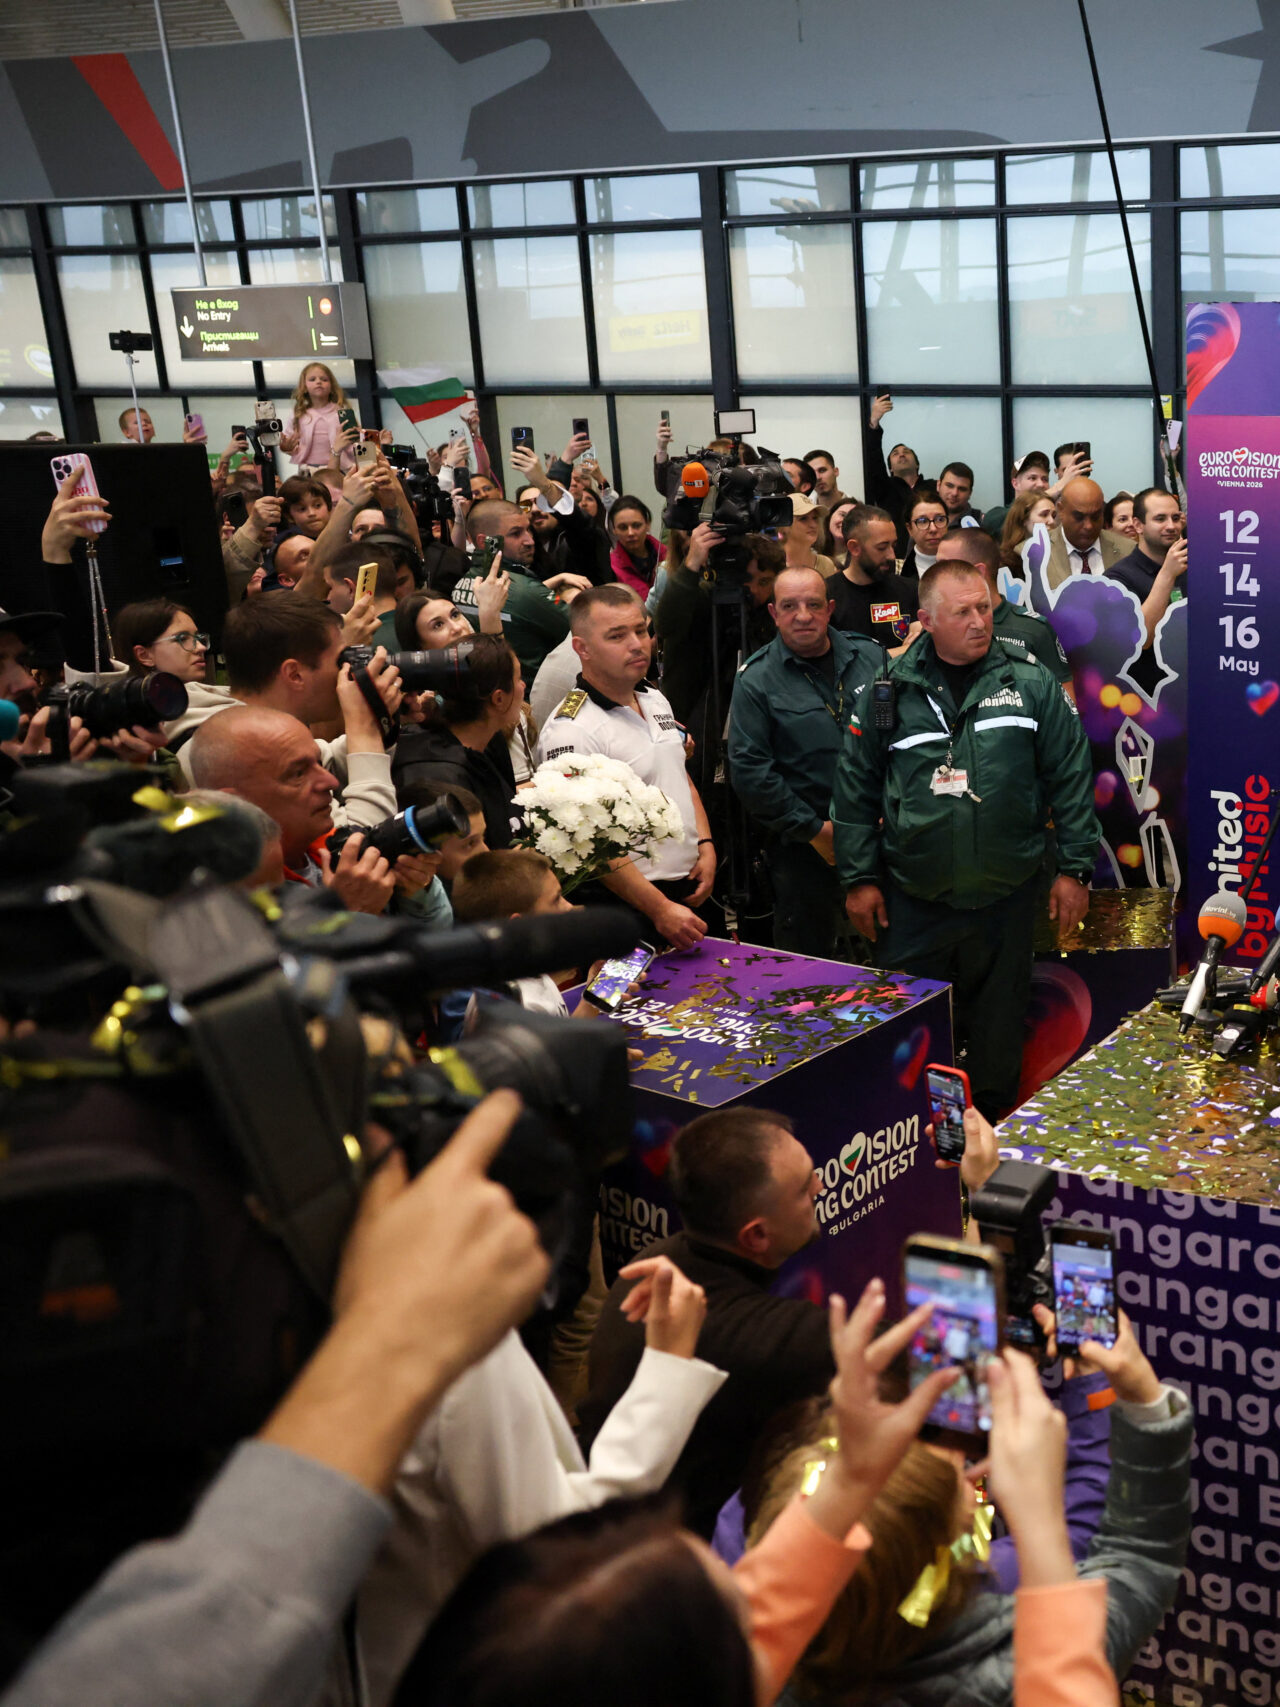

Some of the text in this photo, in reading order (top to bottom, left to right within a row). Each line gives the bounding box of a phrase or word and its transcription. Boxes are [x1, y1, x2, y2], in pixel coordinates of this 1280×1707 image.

[195, 300, 208, 310] Не
[216, 298, 239, 310] вход
[197, 311, 231, 322] No Entry
[202, 342, 230, 351] Arrivals
[1201, 466, 1280, 479] SONG CONTEST
[1217, 480, 1245, 488] VIENNA
[1219, 509, 1260, 544] 12
[1219, 563, 1260, 597] 14
[1219, 615, 1260, 649] 16
[1219, 655, 1259, 676] May
[1208, 790, 1243, 896] nited
[1236, 774, 1276, 958] by Music
[813, 1114, 919, 1200] ROVISION
[814, 1145, 918, 1224] NG CONTEST
[828, 1195, 885, 1235] BULGARIA
